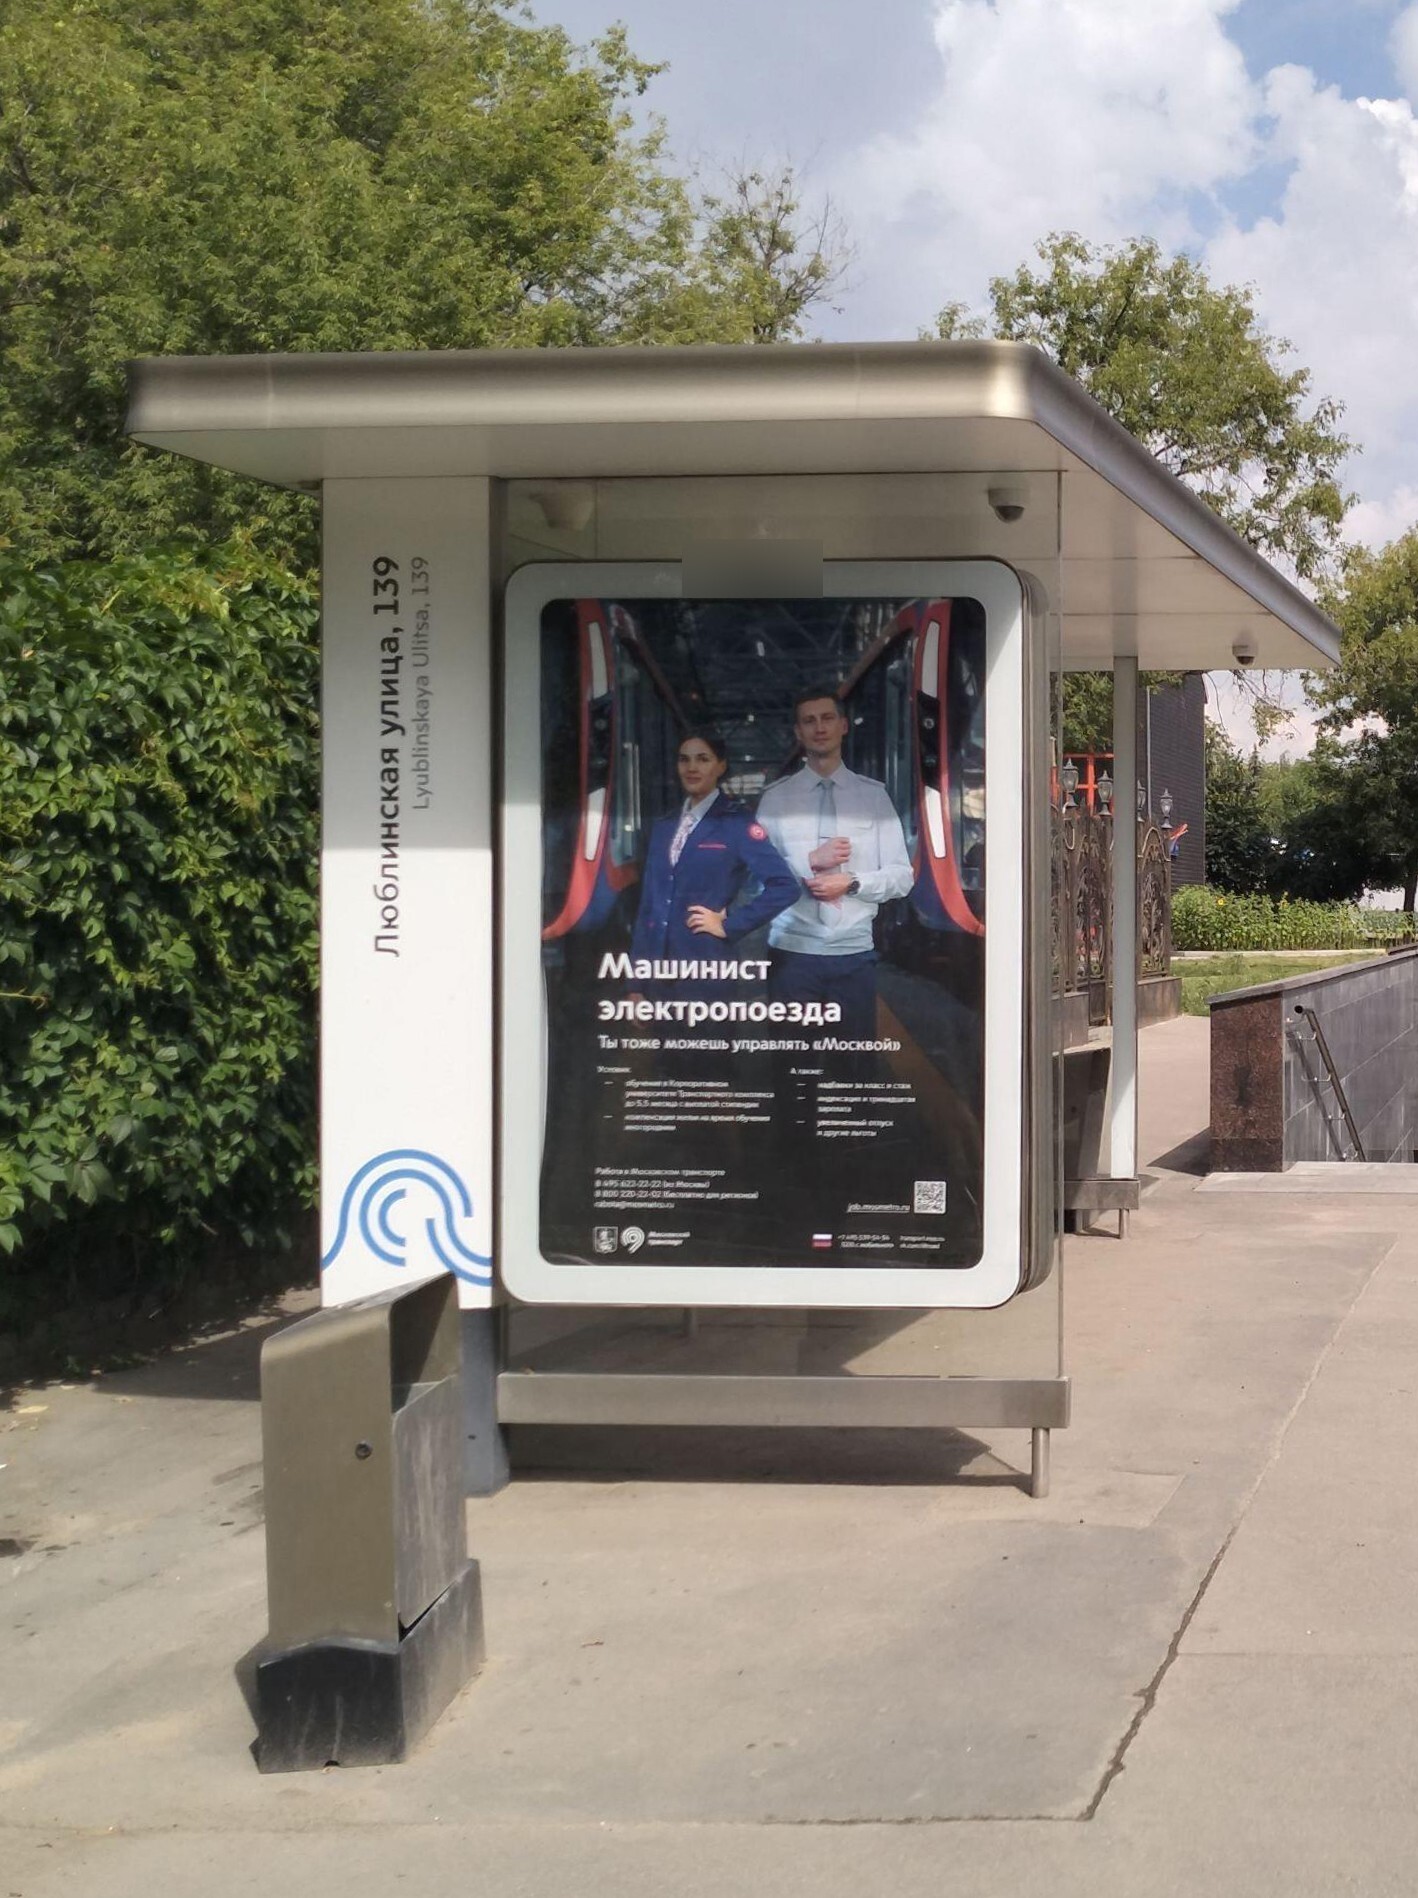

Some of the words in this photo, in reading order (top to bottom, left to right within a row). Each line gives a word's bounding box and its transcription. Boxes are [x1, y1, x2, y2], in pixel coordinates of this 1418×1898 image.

[372, 555, 400, 616] 139
[411, 556, 430, 597] 139
[411, 603, 431, 668] Ulitsa,
[380, 625, 406, 737] улица,
[411, 676, 433, 810] Lyublinskaya
[373, 747, 401, 958] Люблинская
[597, 951, 773, 981] Машинист
[597, 999, 843, 1027] электропоезда
[598, 1035, 618, 1049] Ты
[620, 1038, 661, 1050] тоже
[664, 1038, 730, 1050] можешь
[731, 1038, 810, 1053] управлять
[812, 1037, 902, 1052] «Москвой»
